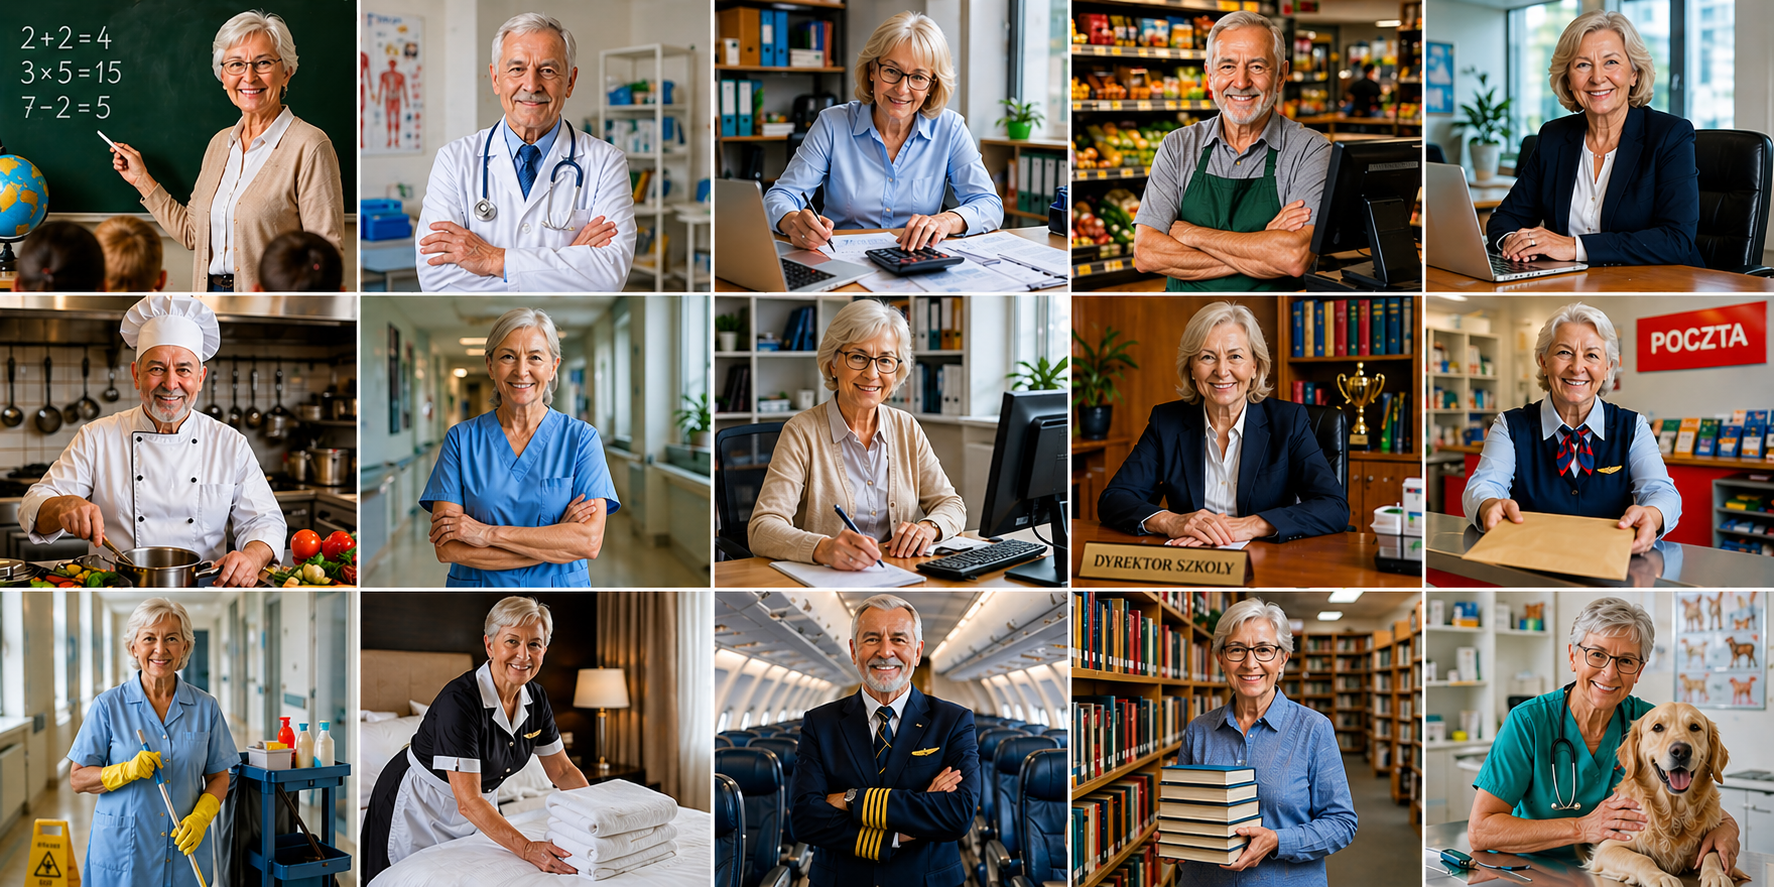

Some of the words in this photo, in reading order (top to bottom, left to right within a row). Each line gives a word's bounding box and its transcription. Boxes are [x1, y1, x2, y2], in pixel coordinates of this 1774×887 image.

[1651, 323, 1748, 355] POCZTA
[1094, 554, 1172, 571] DYREKTOR
[1176, 559, 1235, 575] SZKOLY
